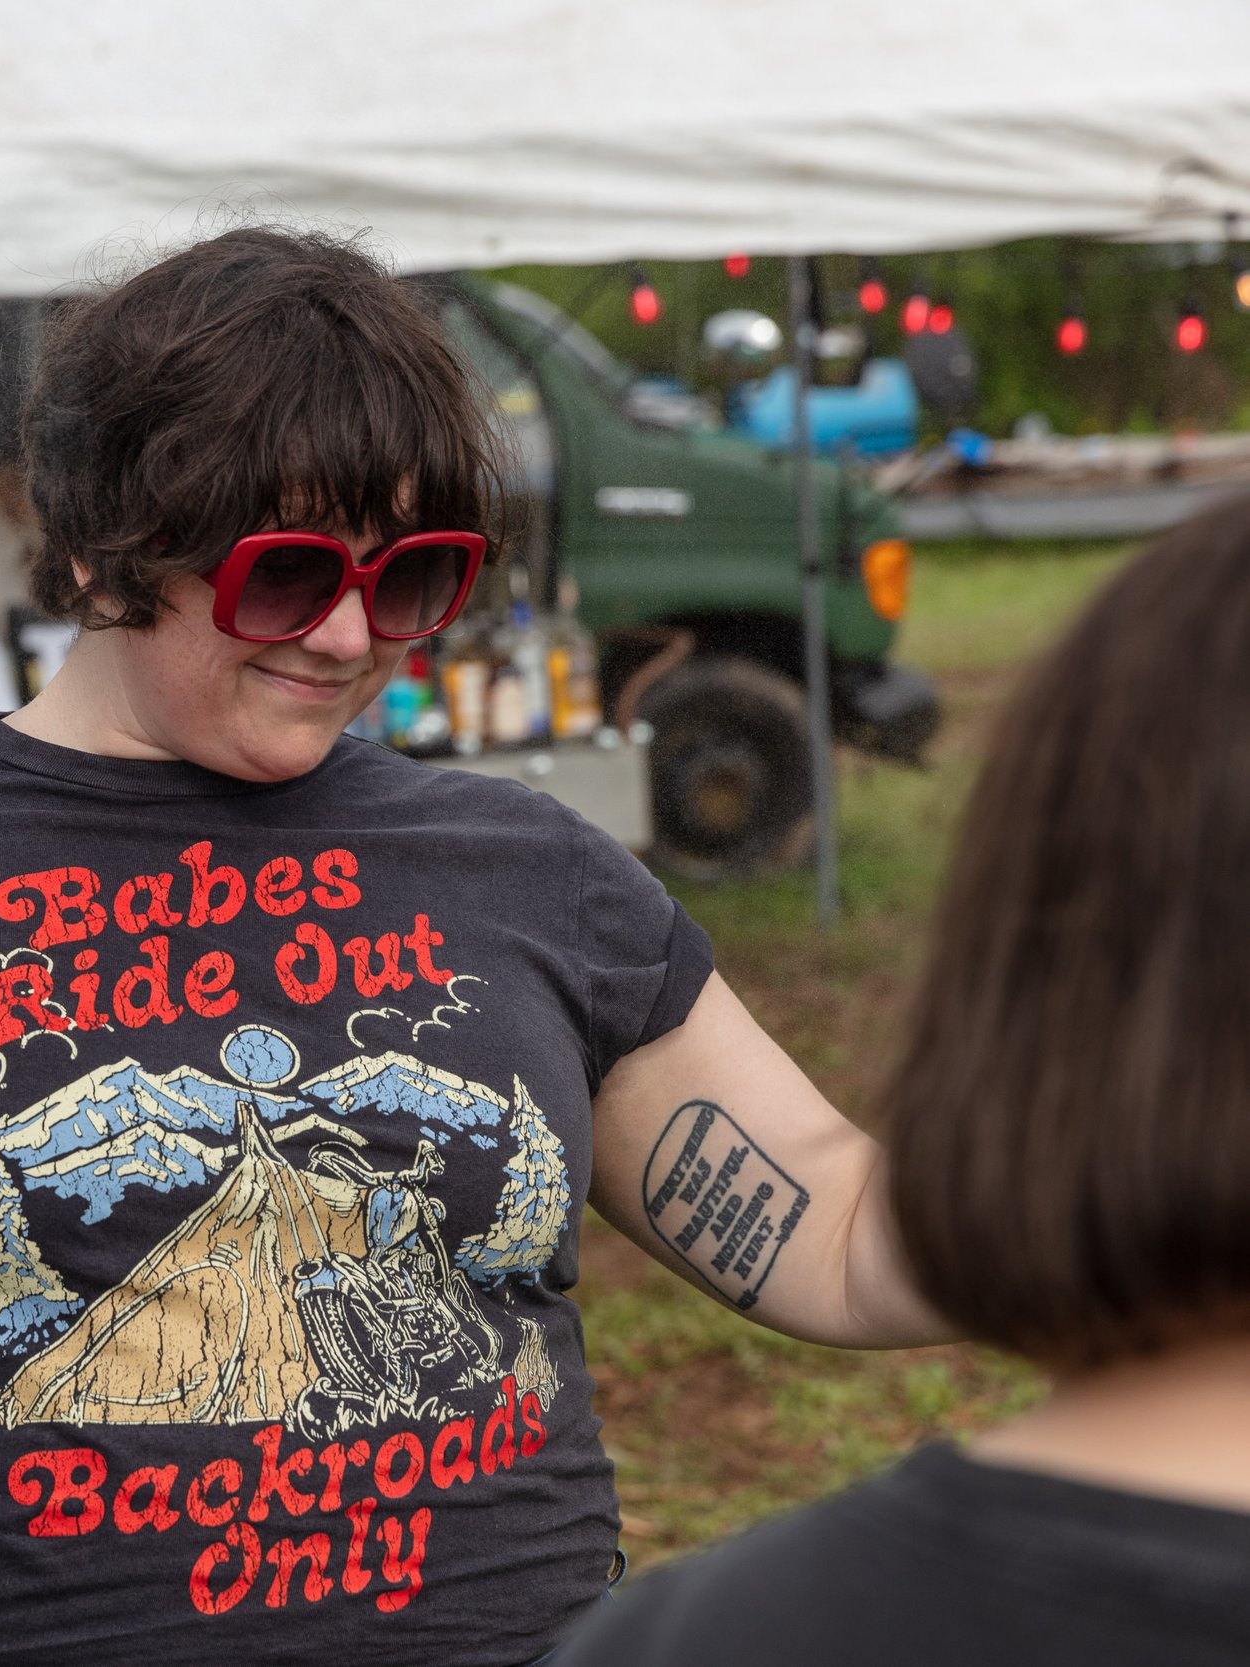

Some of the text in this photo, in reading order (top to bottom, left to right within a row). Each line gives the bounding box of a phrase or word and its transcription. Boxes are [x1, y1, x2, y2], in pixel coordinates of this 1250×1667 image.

[274, 914, 456, 1005] Out
[649, 1108, 715, 1218] EVERYTHING
[678, 1156, 712, 1205] WAS
[710, 1194, 743, 1242] AND
[710, 1182, 774, 1274] NOTHING
[733, 1216, 773, 1280] HURT
[7, 1374, 548, 1537] Backroads
[188, 1497, 433, 1616] Only
